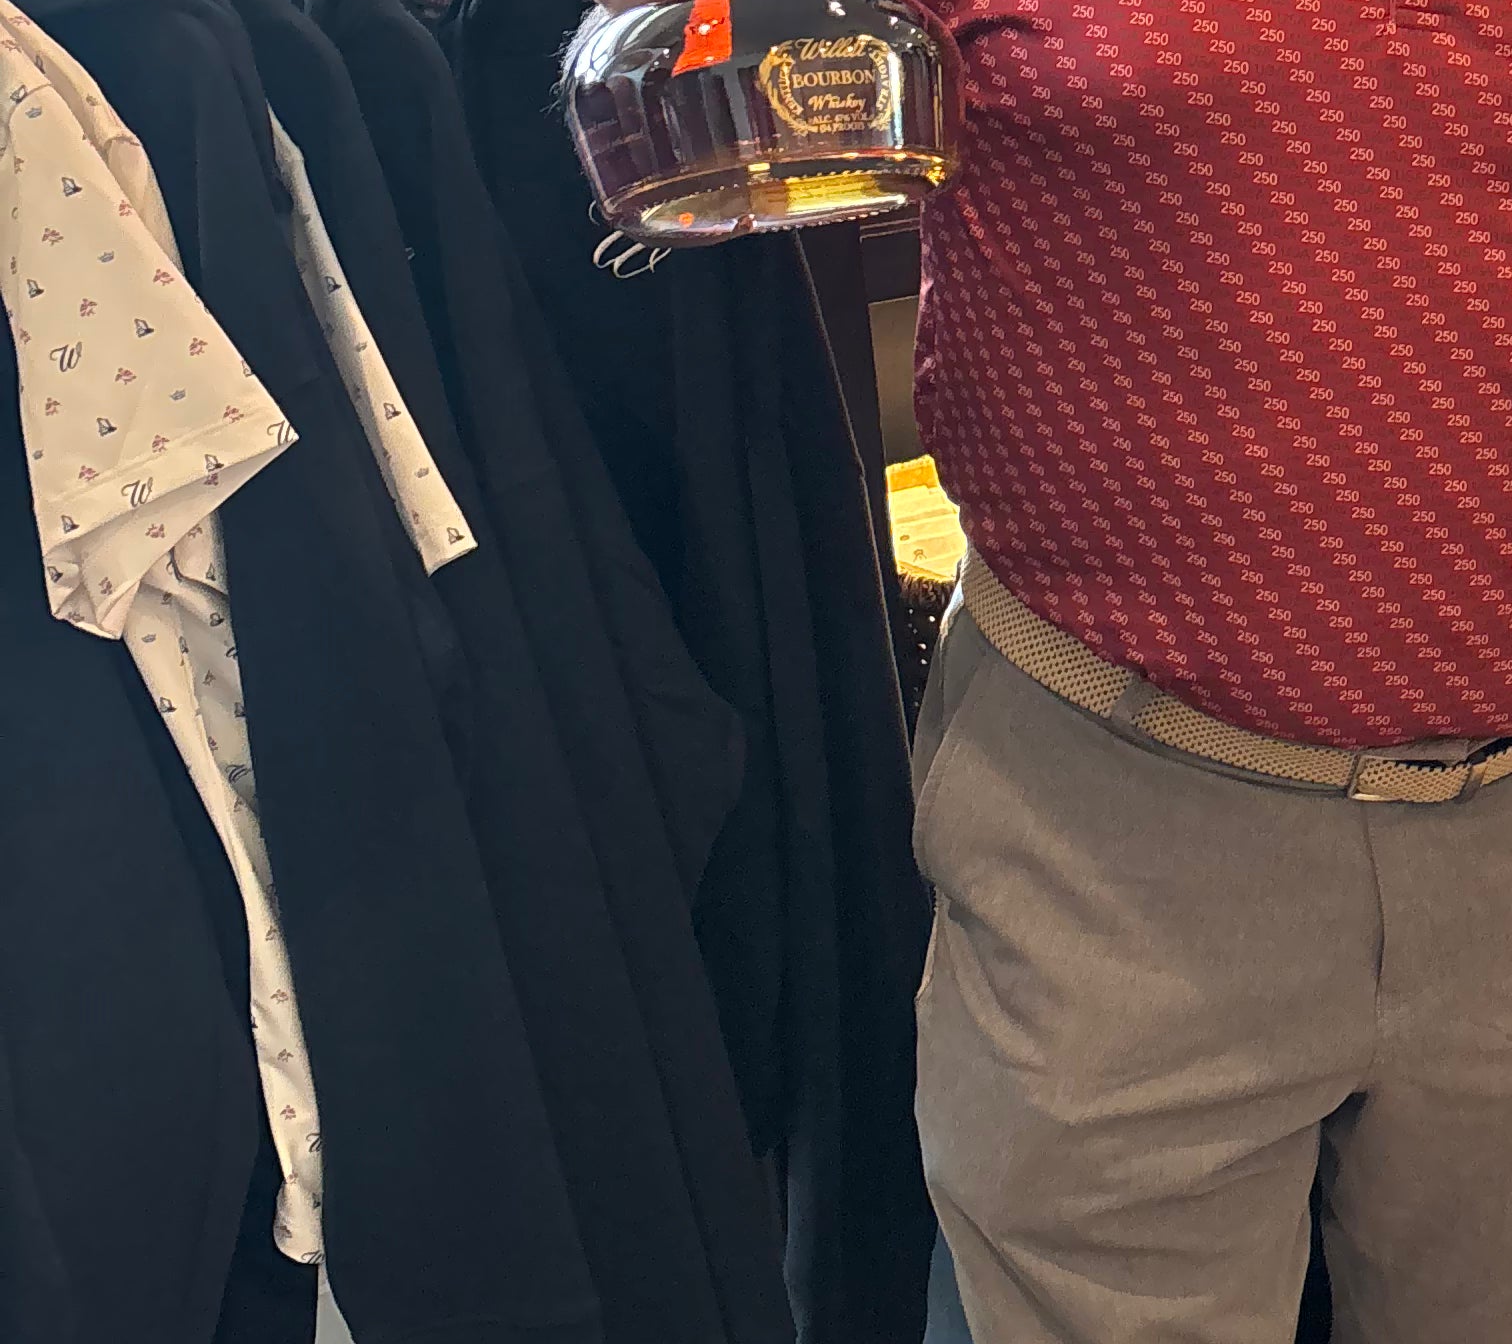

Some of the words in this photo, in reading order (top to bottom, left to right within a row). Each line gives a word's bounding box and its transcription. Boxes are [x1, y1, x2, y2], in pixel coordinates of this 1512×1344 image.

[794, 37, 870, 61] Willett
[791, 69, 877, 90] BOURBON
[1411, 153, 1436, 169] 250
[1177, 278, 1200, 294] 250
[50, 342, 84, 373] W
[1490, 398, 1512, 412] 250
[1292, 435, 1317, 450] 250
[120, 478, 155, 507] W
